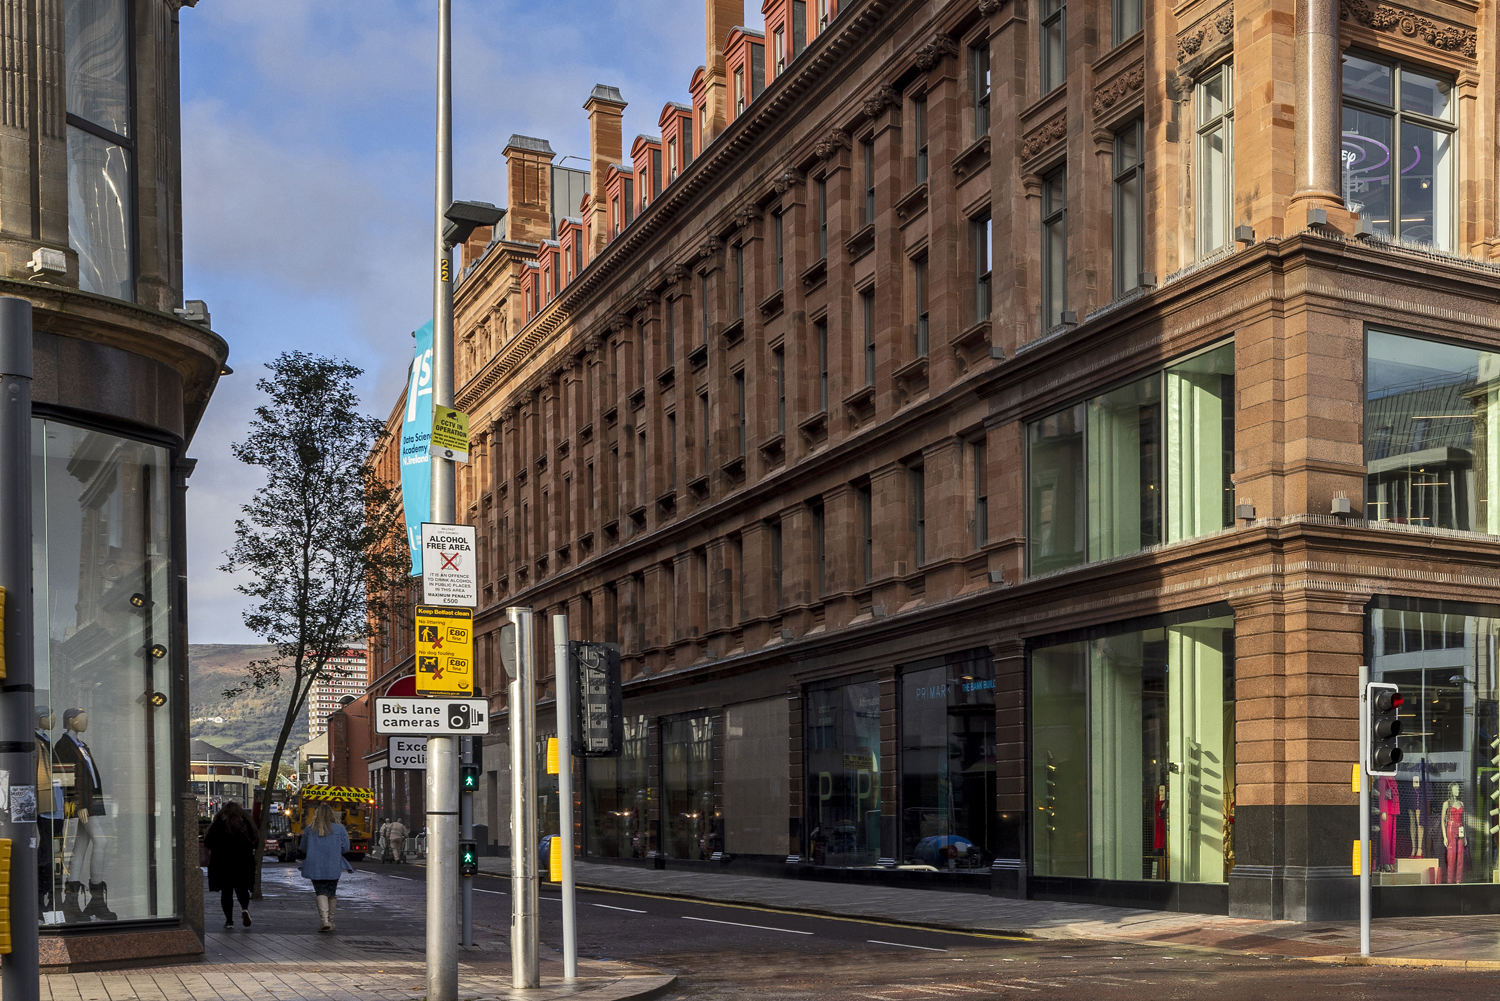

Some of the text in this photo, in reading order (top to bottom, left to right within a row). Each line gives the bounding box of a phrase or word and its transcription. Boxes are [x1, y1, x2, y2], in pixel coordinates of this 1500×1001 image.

[407, 348, 433, 423] 1S
[440, 419, 463, 431] CCTV IN
[435, 424, 467, 438] OPERATION
[402, 444, 428, 455] Academy
[429, 535, 468, 544] ALCOHOL
[426, 542, 471, 551] FREE AREA
[449, 629, 466, 637] £80
[449, 659, 466, 667] £80
[916, 683, 951, 701] PRIMARK
[962, 682, 970, 692] THE
[970, 681, 983, 692] BANK
[382, 703, 441, 715] Bus lane
[383, 717, 440, 728] cameras
[305, 789, 371, 799] ROAD MARKINGS
